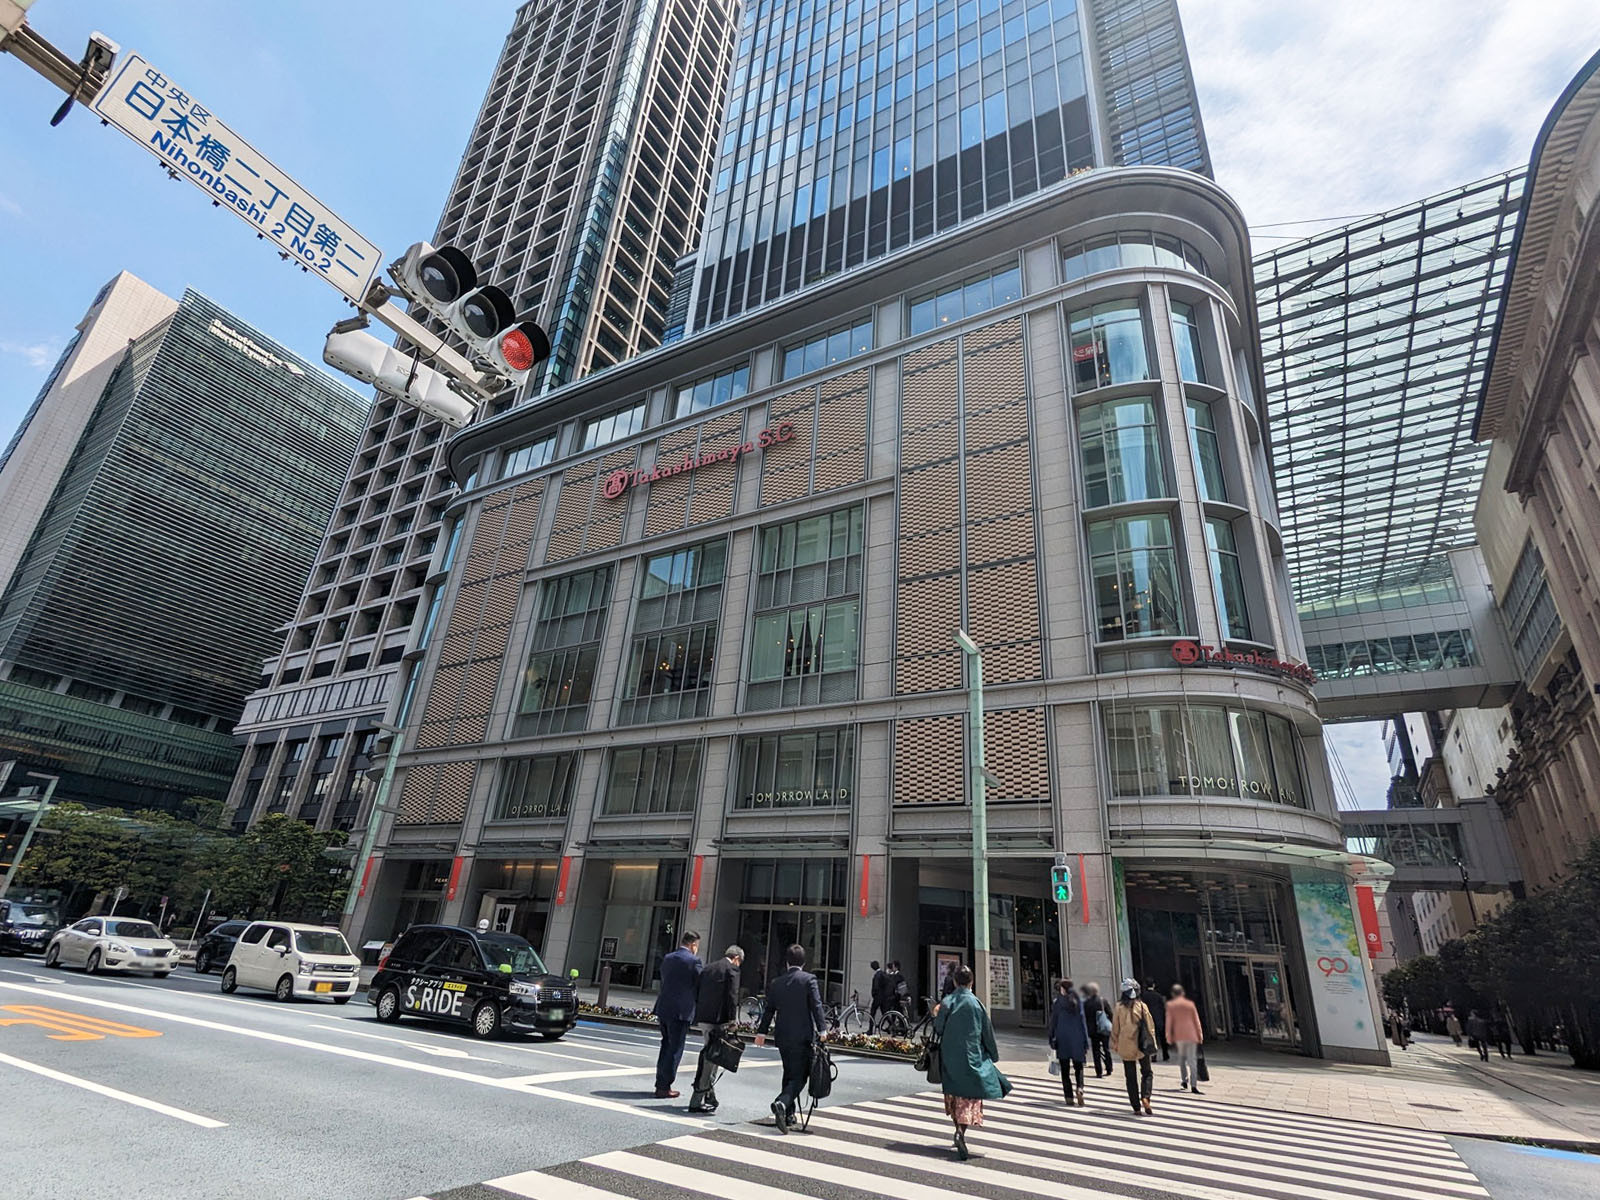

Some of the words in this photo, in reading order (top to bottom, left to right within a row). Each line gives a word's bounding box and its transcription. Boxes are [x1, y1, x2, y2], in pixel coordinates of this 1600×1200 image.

[145, 69, 212, 126] 中央区
[125, 80, 365, 277] 日本橋二丁目第二
[150, 130, 268, 225] Nihonbashi
[271, 222, 286, 239] 2
[290, 235, 332, 274] No.2
[629, 441, 754, 487] Takashimaya
[405, 985, 465, 1016] S.RIDE
